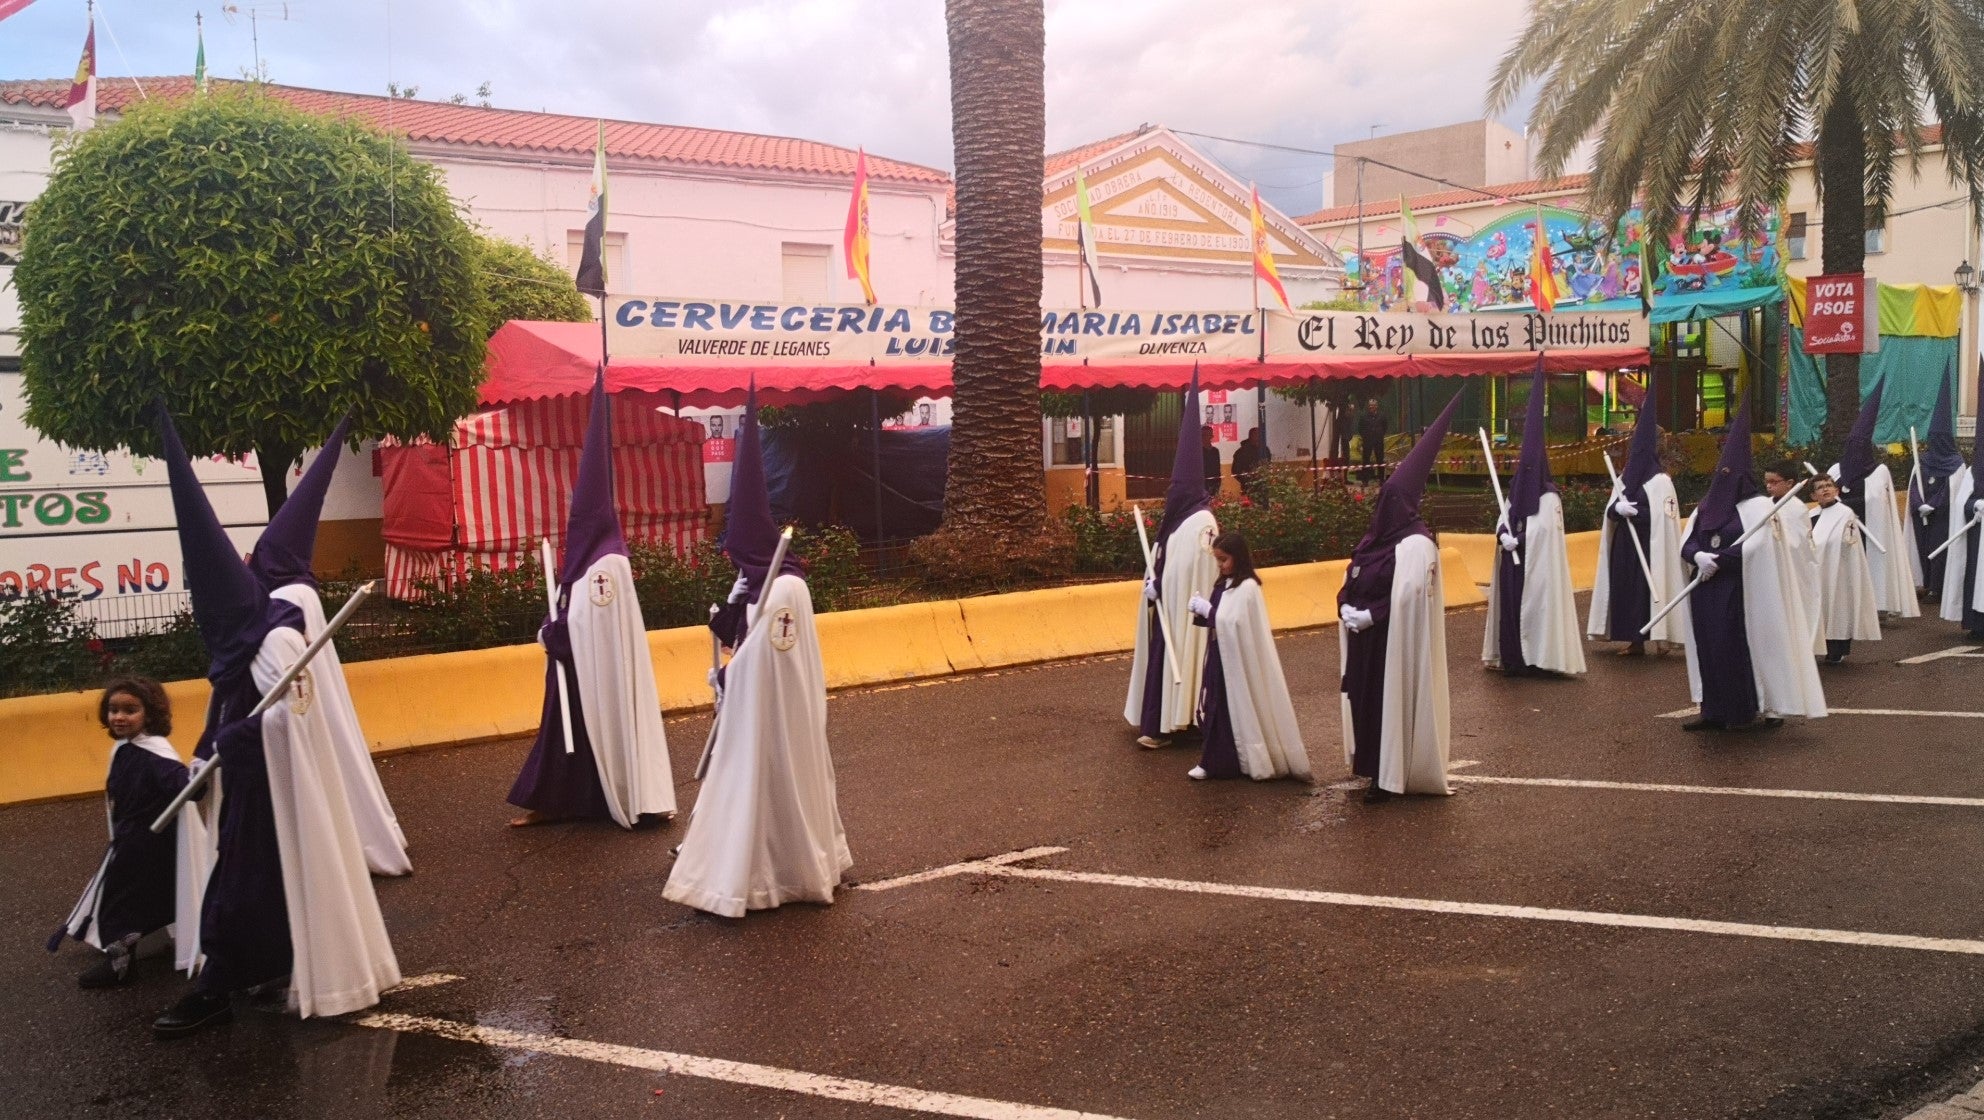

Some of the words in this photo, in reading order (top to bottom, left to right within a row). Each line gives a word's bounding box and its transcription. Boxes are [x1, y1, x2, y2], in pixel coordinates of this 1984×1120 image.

[1054, 187, 1102, 218] SOCIAD
[1058, 223, 1105, 240] FUNDA
[1107, 227, 1120, 241] EL
[1124, 229, 1136, 242] 27
[1140, 230, 1152, 243] DE
[1814, 282, 1854, 298] VOTA
[615, 300, 911, 335] CERVECERIA
[1150, 313, 1255, 336] ISABEL
[1813, 301, 1855, 316] PSOE
[1298, 314, 1337, 351] El
[1353, 314, 1414, 355] Rey
[1427, 319, 1457, 350] de
[1470, 318, 1510, 350] los
[1522, 313, 1631, 351] Pinchitos
[678, 339, 746, 355] VALVERDE
[750, 340, 769, 356] DE
[773, 340, 831, 357] LEGANES
[886, 337, 957, 359] LUIS
[1139, 341, 1208, 355] OLIVENZA
[0, 491, 112, 528] TOS
[117, 558, 170, 594] NO
